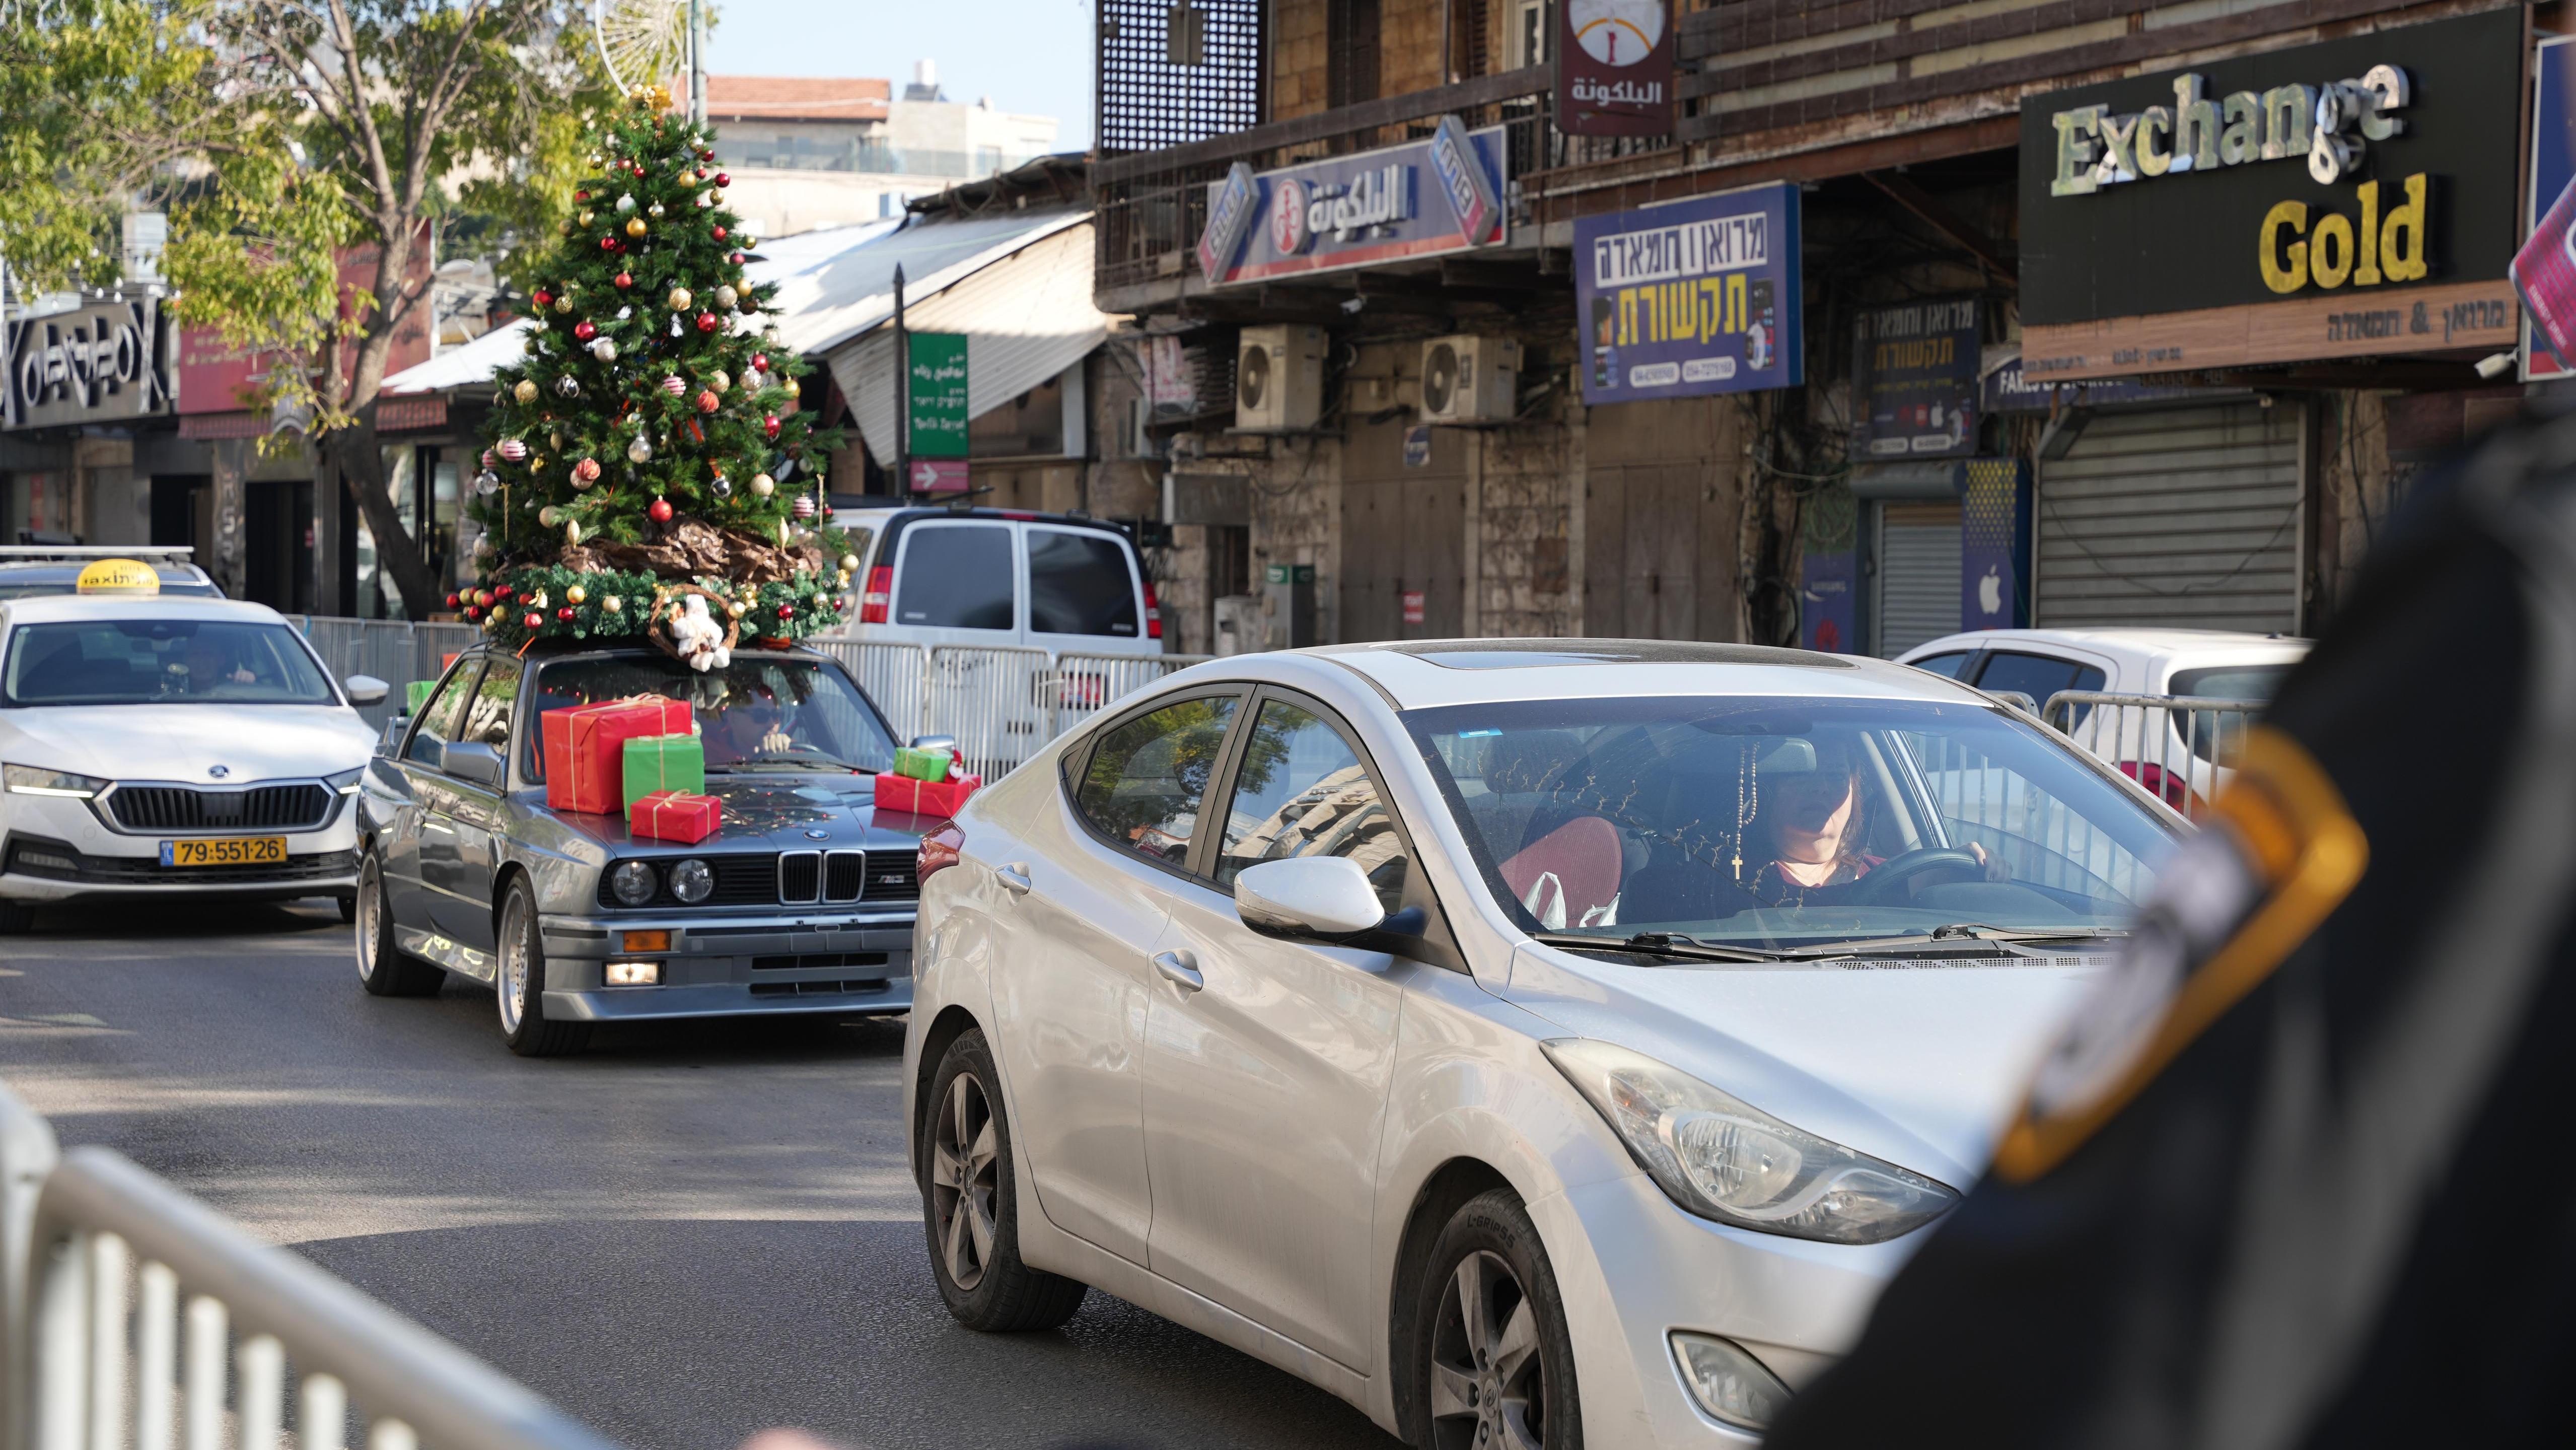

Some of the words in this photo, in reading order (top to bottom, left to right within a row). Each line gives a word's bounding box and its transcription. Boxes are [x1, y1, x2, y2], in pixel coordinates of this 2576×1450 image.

[1571, 77, 1662, 109] البلكونة
[2051, 63, 2409, 197] Exchange
[1309, 163, 1400, 243] البلكونة
[1701, 217, 1764, 276] מרואן
[2259, 172, 2427, 294] Gold
[1617, 273, 1747, 346] תקשורת
[2328, 310, 2402, 341] חמאדה
[2410, 300, 2432, 334] &
[2443, 299, 2507, 343] מרואן
[2529, 284, 2552, 323] ENERGY
[2547, 318, 2568, 351] DRINK
[1873, 337, 1955, 371] תקשורת
